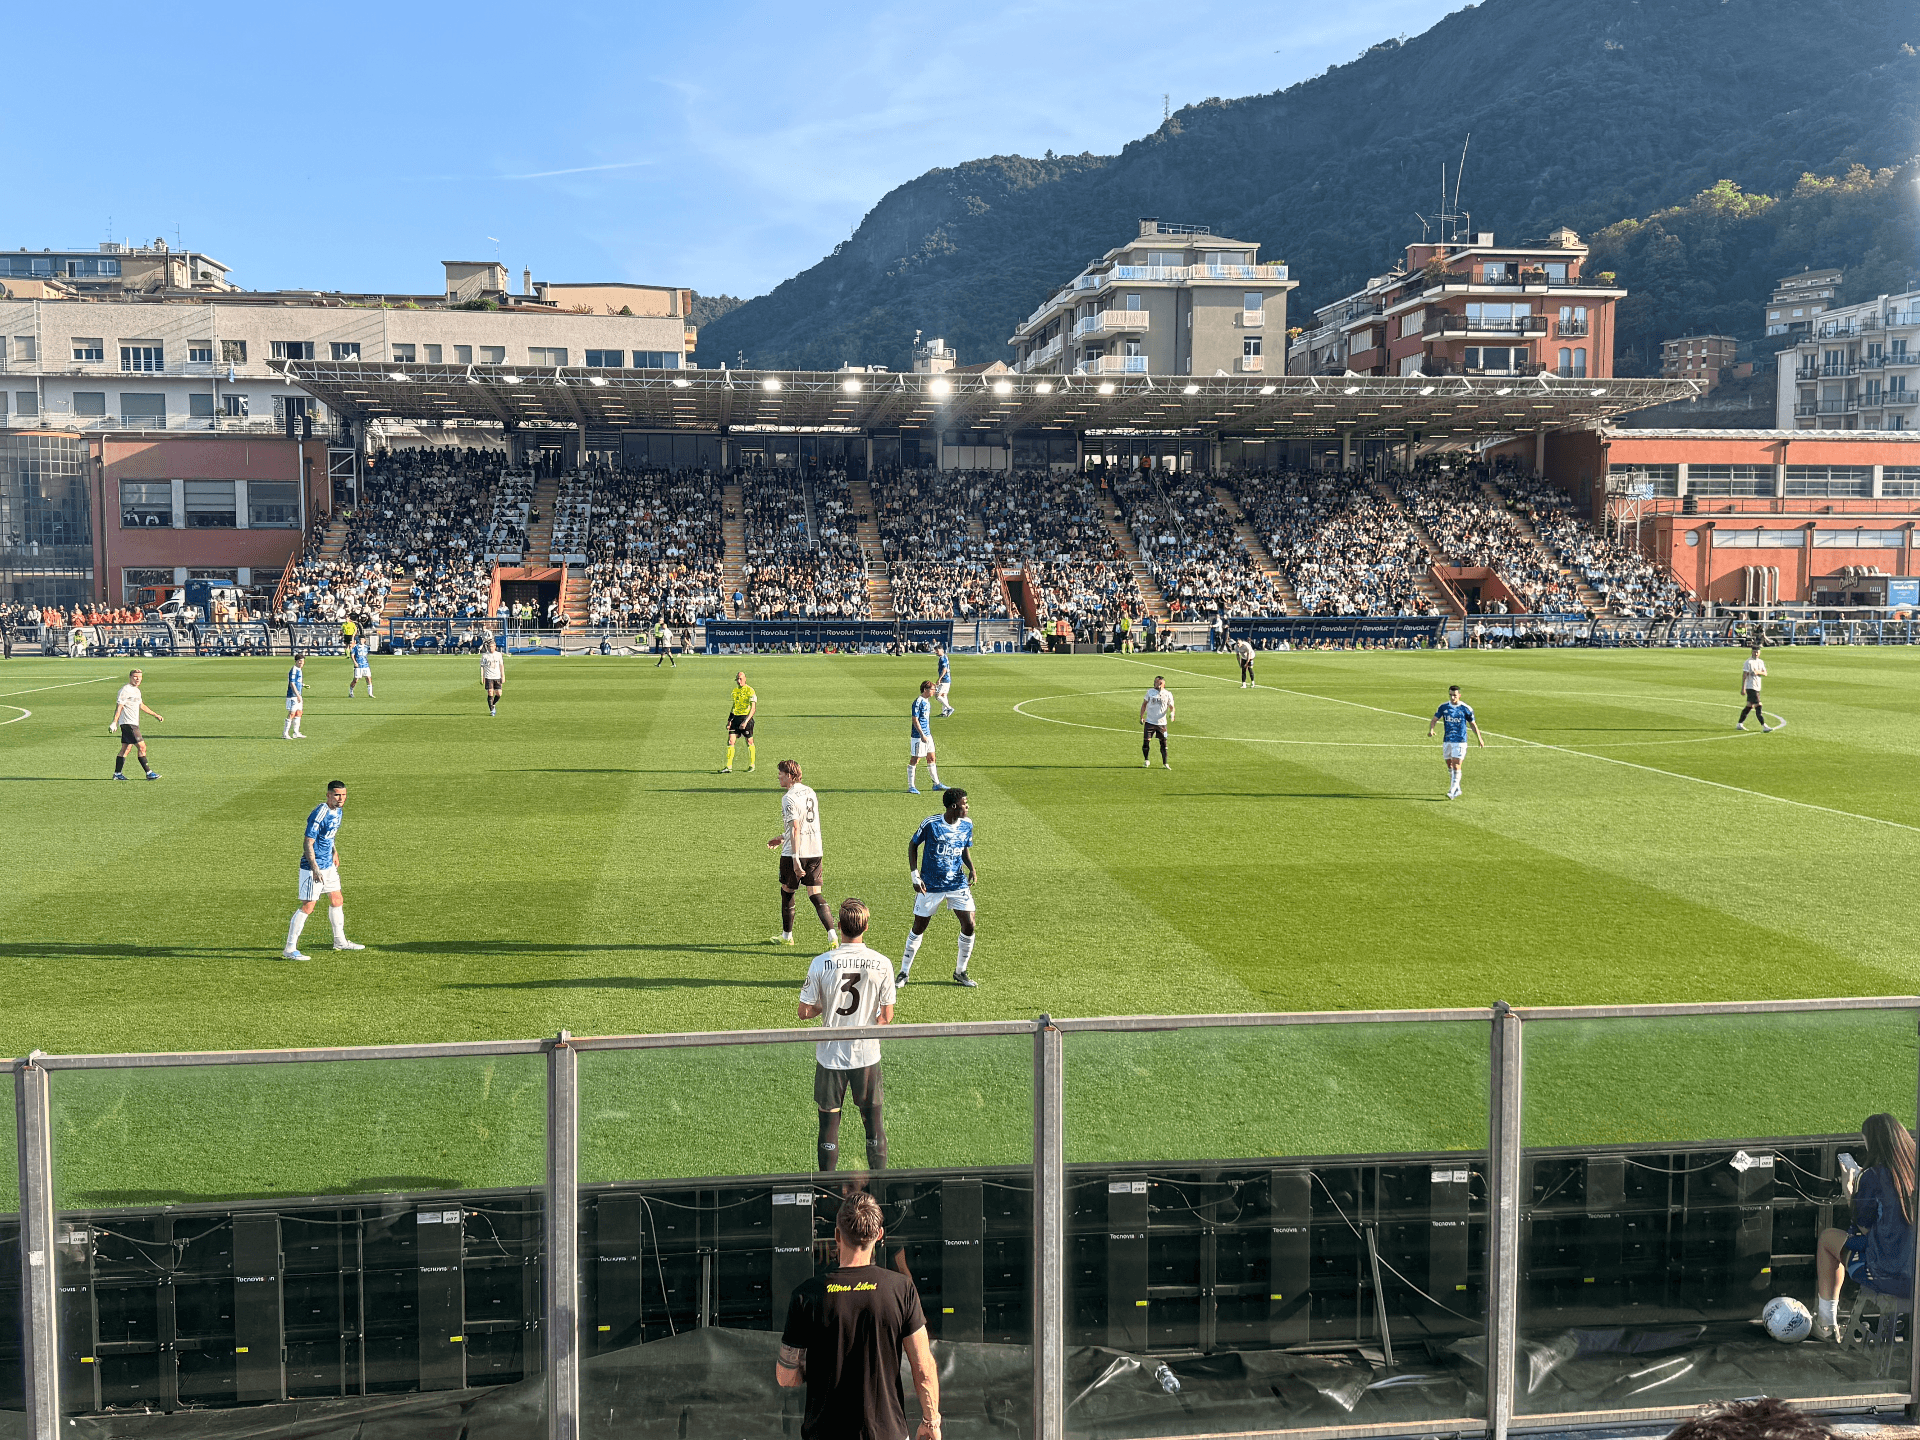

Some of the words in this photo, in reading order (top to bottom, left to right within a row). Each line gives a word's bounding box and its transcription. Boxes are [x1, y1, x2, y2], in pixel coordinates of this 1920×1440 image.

[913, 628, 941, 636] Revolut
[1228, 625, 1244, 633] olut
[1361, 624, 1389, 632] Revolut
[1402, 624, 1430, 632] Revolut
[806, 797, 815, 823] 8
[936, 843, 964, 856] Uber
[835, 972, 861, 1016] 3
